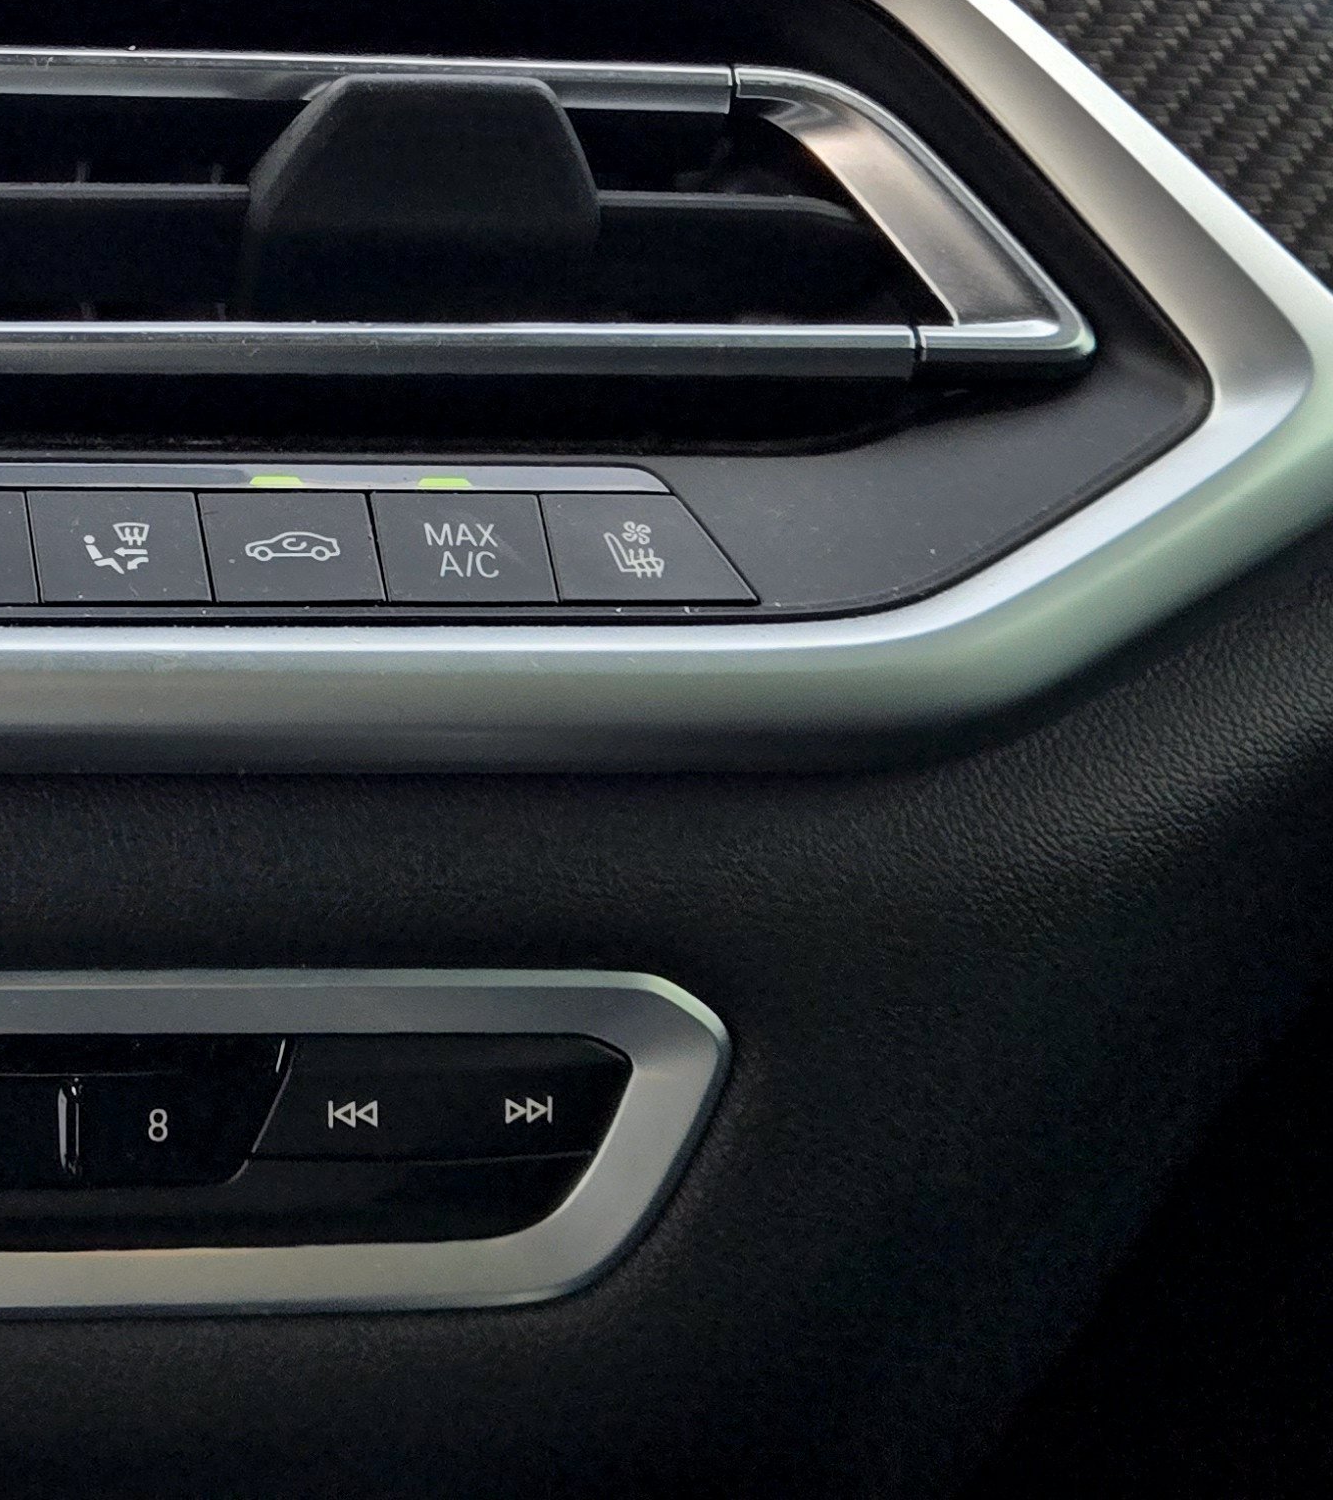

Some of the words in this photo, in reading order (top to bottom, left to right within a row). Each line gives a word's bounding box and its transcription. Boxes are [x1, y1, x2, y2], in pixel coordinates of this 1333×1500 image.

[424, 522, 496, 548] MAX
[439, 551, 501, 579] A/C
[148, 1109, 168, 1143] 8
